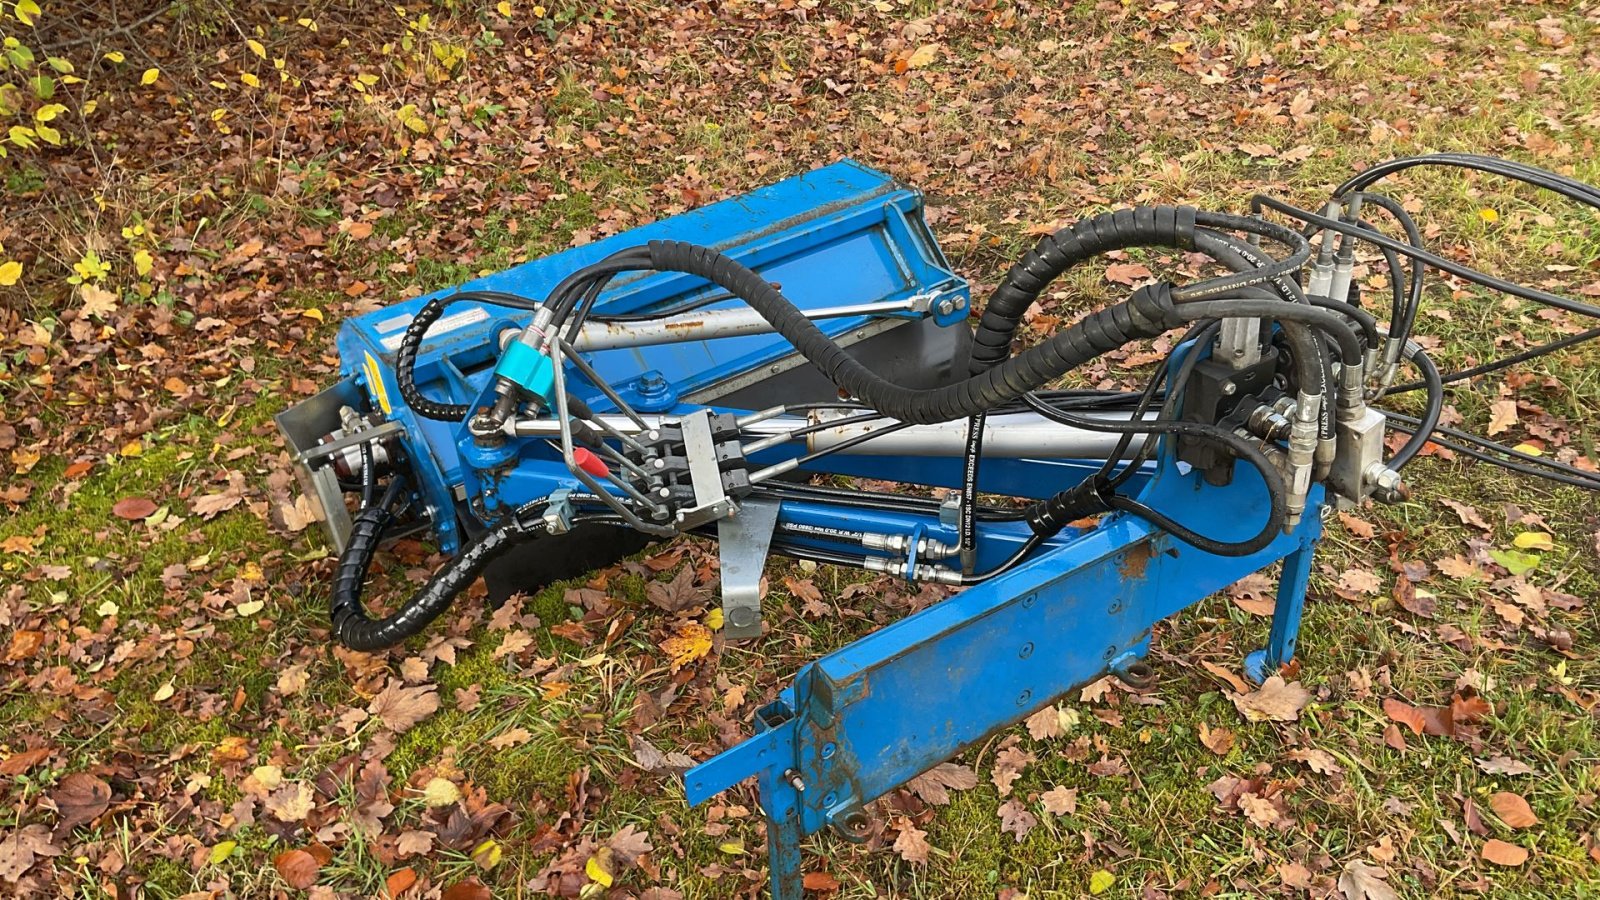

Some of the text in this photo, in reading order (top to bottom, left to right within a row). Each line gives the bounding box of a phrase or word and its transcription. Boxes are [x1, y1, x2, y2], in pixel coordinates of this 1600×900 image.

[972, 411, 983, 439] YPRESS
[1320, 411, 1329, 440] YPRESS
[966, 454, 976, 482] EXCEEDS
